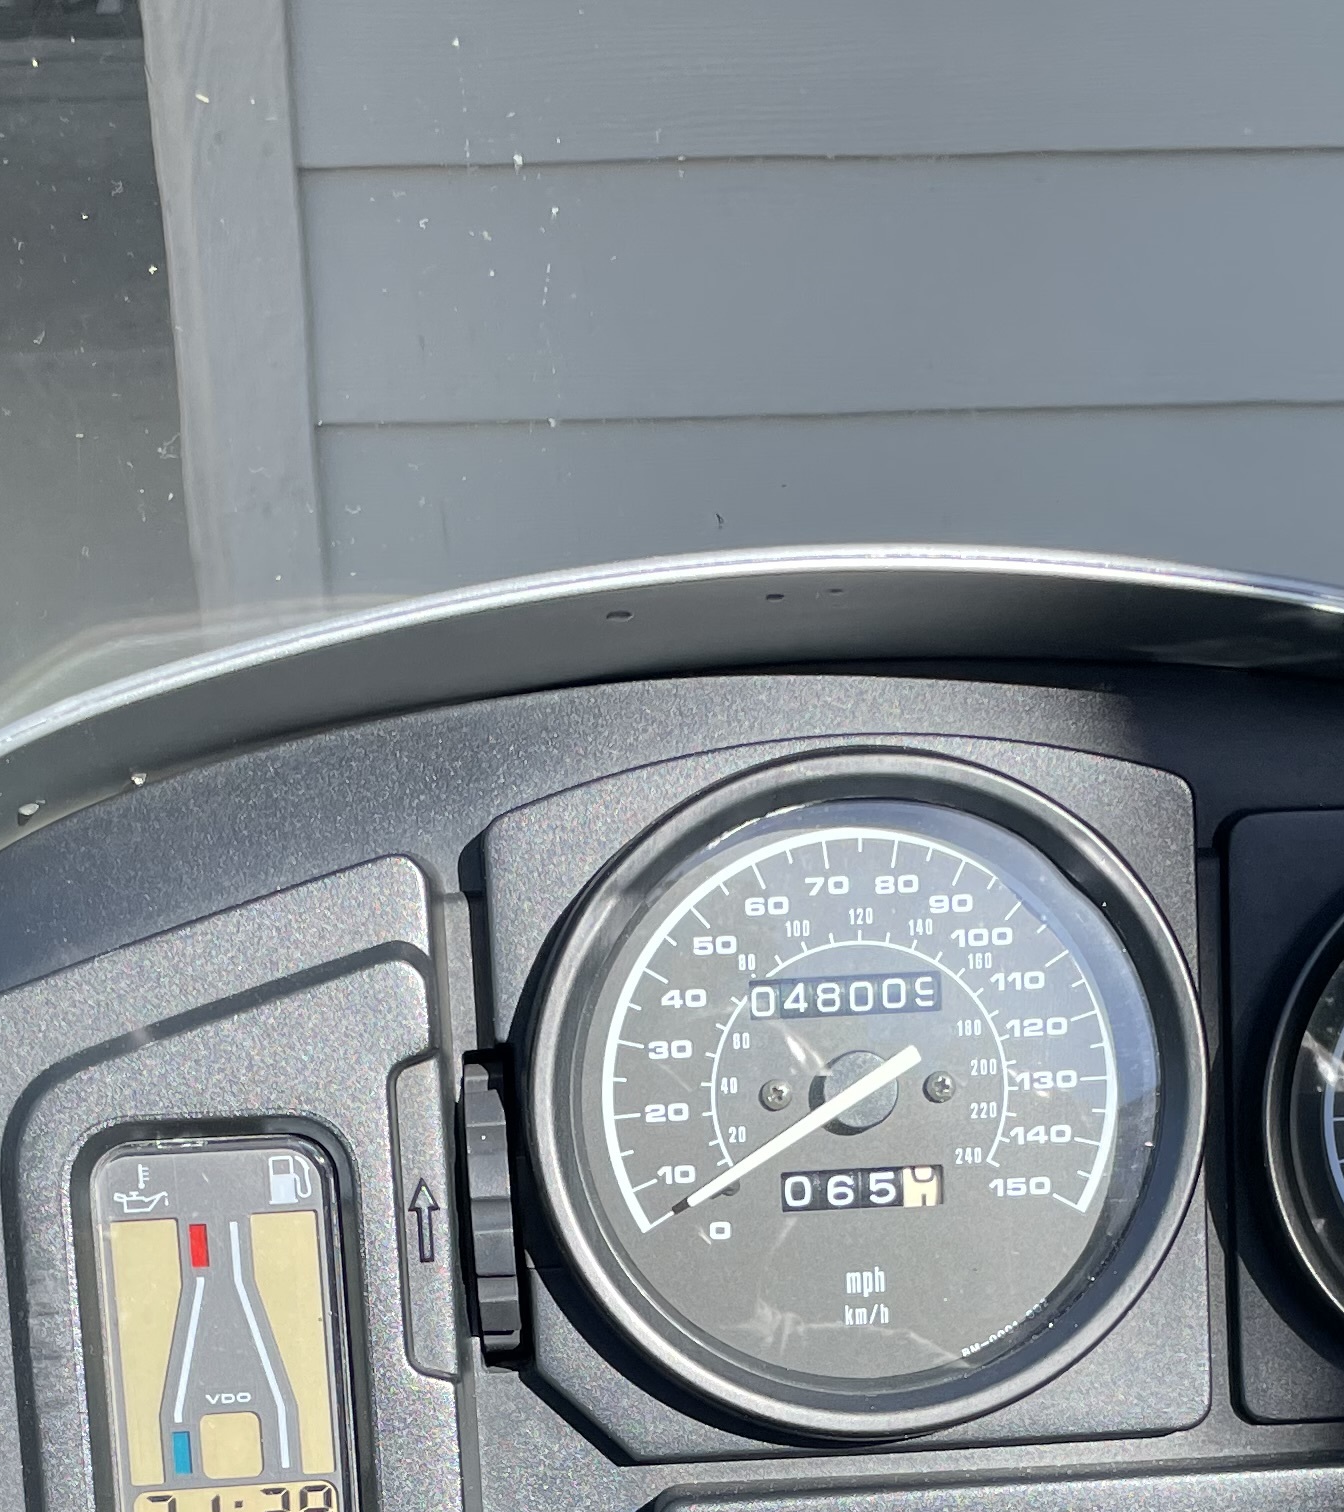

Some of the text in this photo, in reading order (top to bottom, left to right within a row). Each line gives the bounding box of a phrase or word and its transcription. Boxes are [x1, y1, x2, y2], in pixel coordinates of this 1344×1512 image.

[805, 876, 849, 895] 70
[875, 875, 918, 894] 80
[745, 896, 789, 916] 60
[929, 894, 973, 913] 90
[849, 908, 872, 924] 120
[786, 920, 809, 937] 100
[909, 919, 932, 935] 140
[694, 936, 736, 955] 50
[951, 927, 1012, 947] 100
[739, 954, 755, 970] 80
[968, 953, 992, 969] 160
[990, 971, 1044, 990] 110
[662, 989, 706, 1008] 40
[957, 1019, 981, 1036] 180
[1006, 1018, 1067, 1037] 120
[649, 1040, 692, 1059] 30
[971, 1059, 996, 1075] 200
[721, 1078, 737, 1093] 40
[1015, 1070, 1077, 1090] 130
[645, 1103, 689, 1122] 20
[971, 1102, 997, 1118] 220
[729, 1126, 746, 1143] 20
[1010, 1125, 1071, 1144] 140
[956, 1148, 981, 1164] 240
[658, 1165, 695, 1184] 10
[989, 1177, 1050, 1196] 150
[710, 1222, 731, 1239] 0
[847, 1267, 885, 1297] mph
[845, 1304, 888, 1325] km/h
[205, 1393, 252, 1405] VDO
